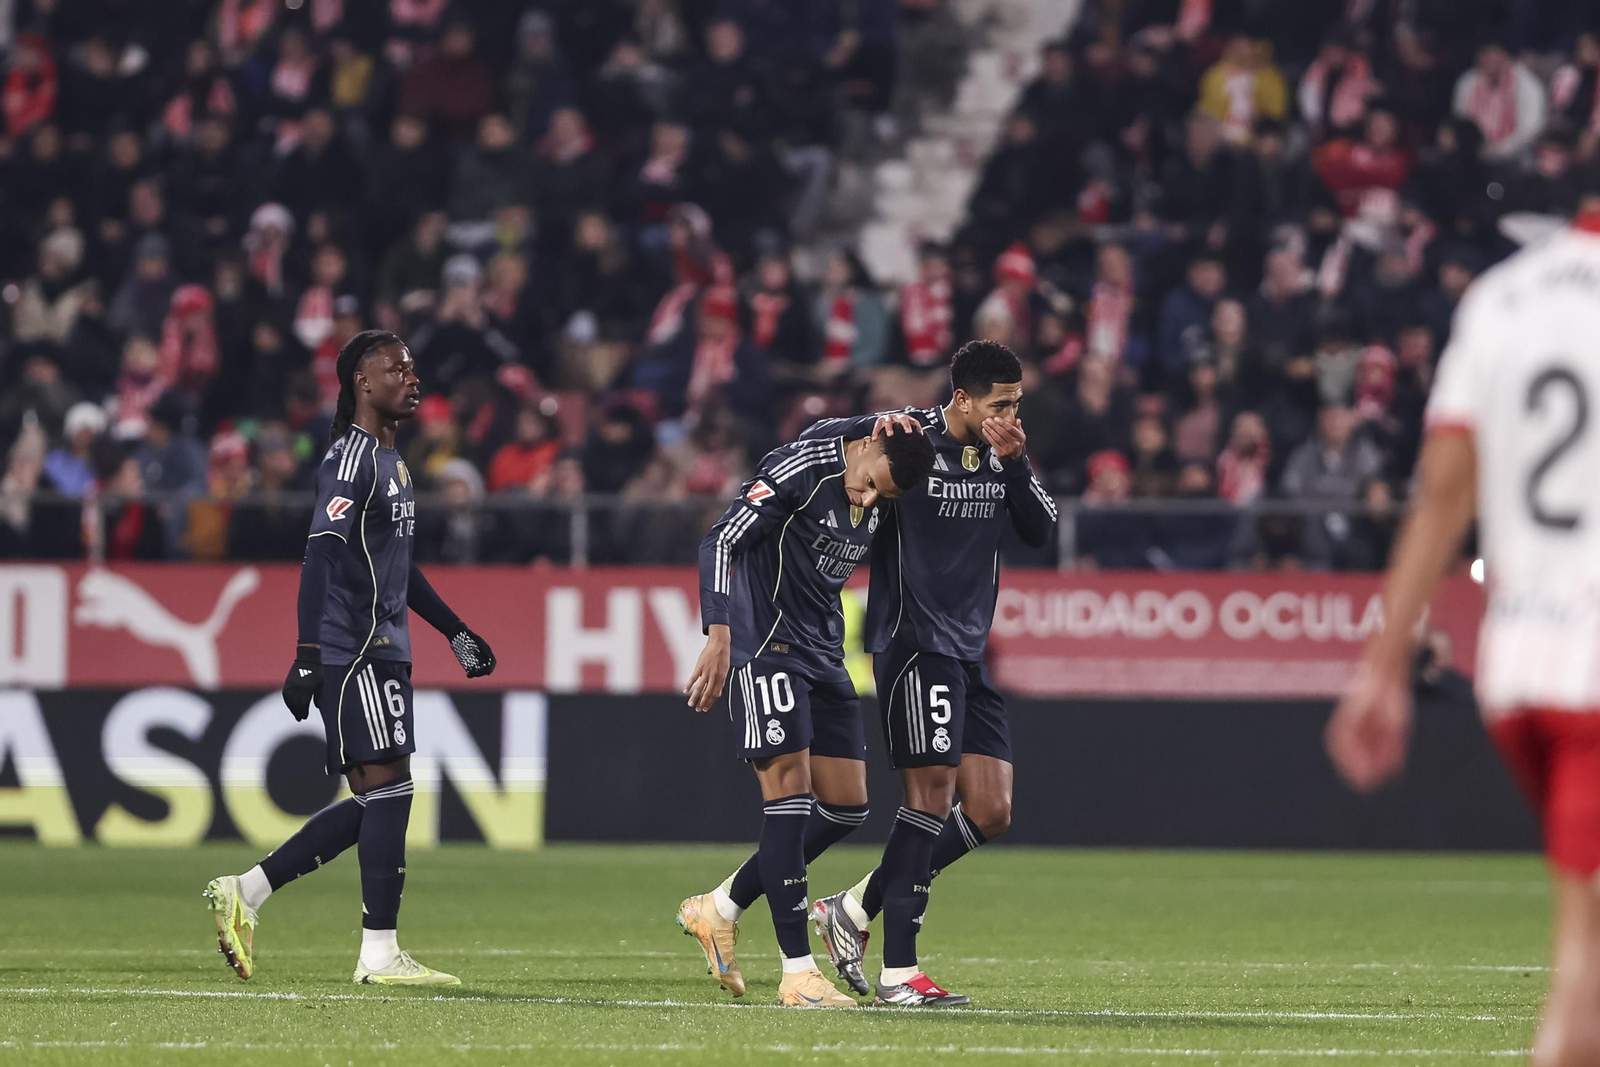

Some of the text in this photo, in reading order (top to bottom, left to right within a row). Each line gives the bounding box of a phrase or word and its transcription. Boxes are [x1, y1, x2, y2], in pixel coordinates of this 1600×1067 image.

[927, 476, 1006, 499] Emirates
[938, 501, 996, 519] FLY BETTER
[811, 533, 868, 561] Emirate
[815, 554, 856, 578] FLY BETTE
[990, 588, 1213, 639] CUIDADO
[383, 679, 405, 718] 6
[755, 672, 795, 716] 10
[929, 684, 951, 725] 5
